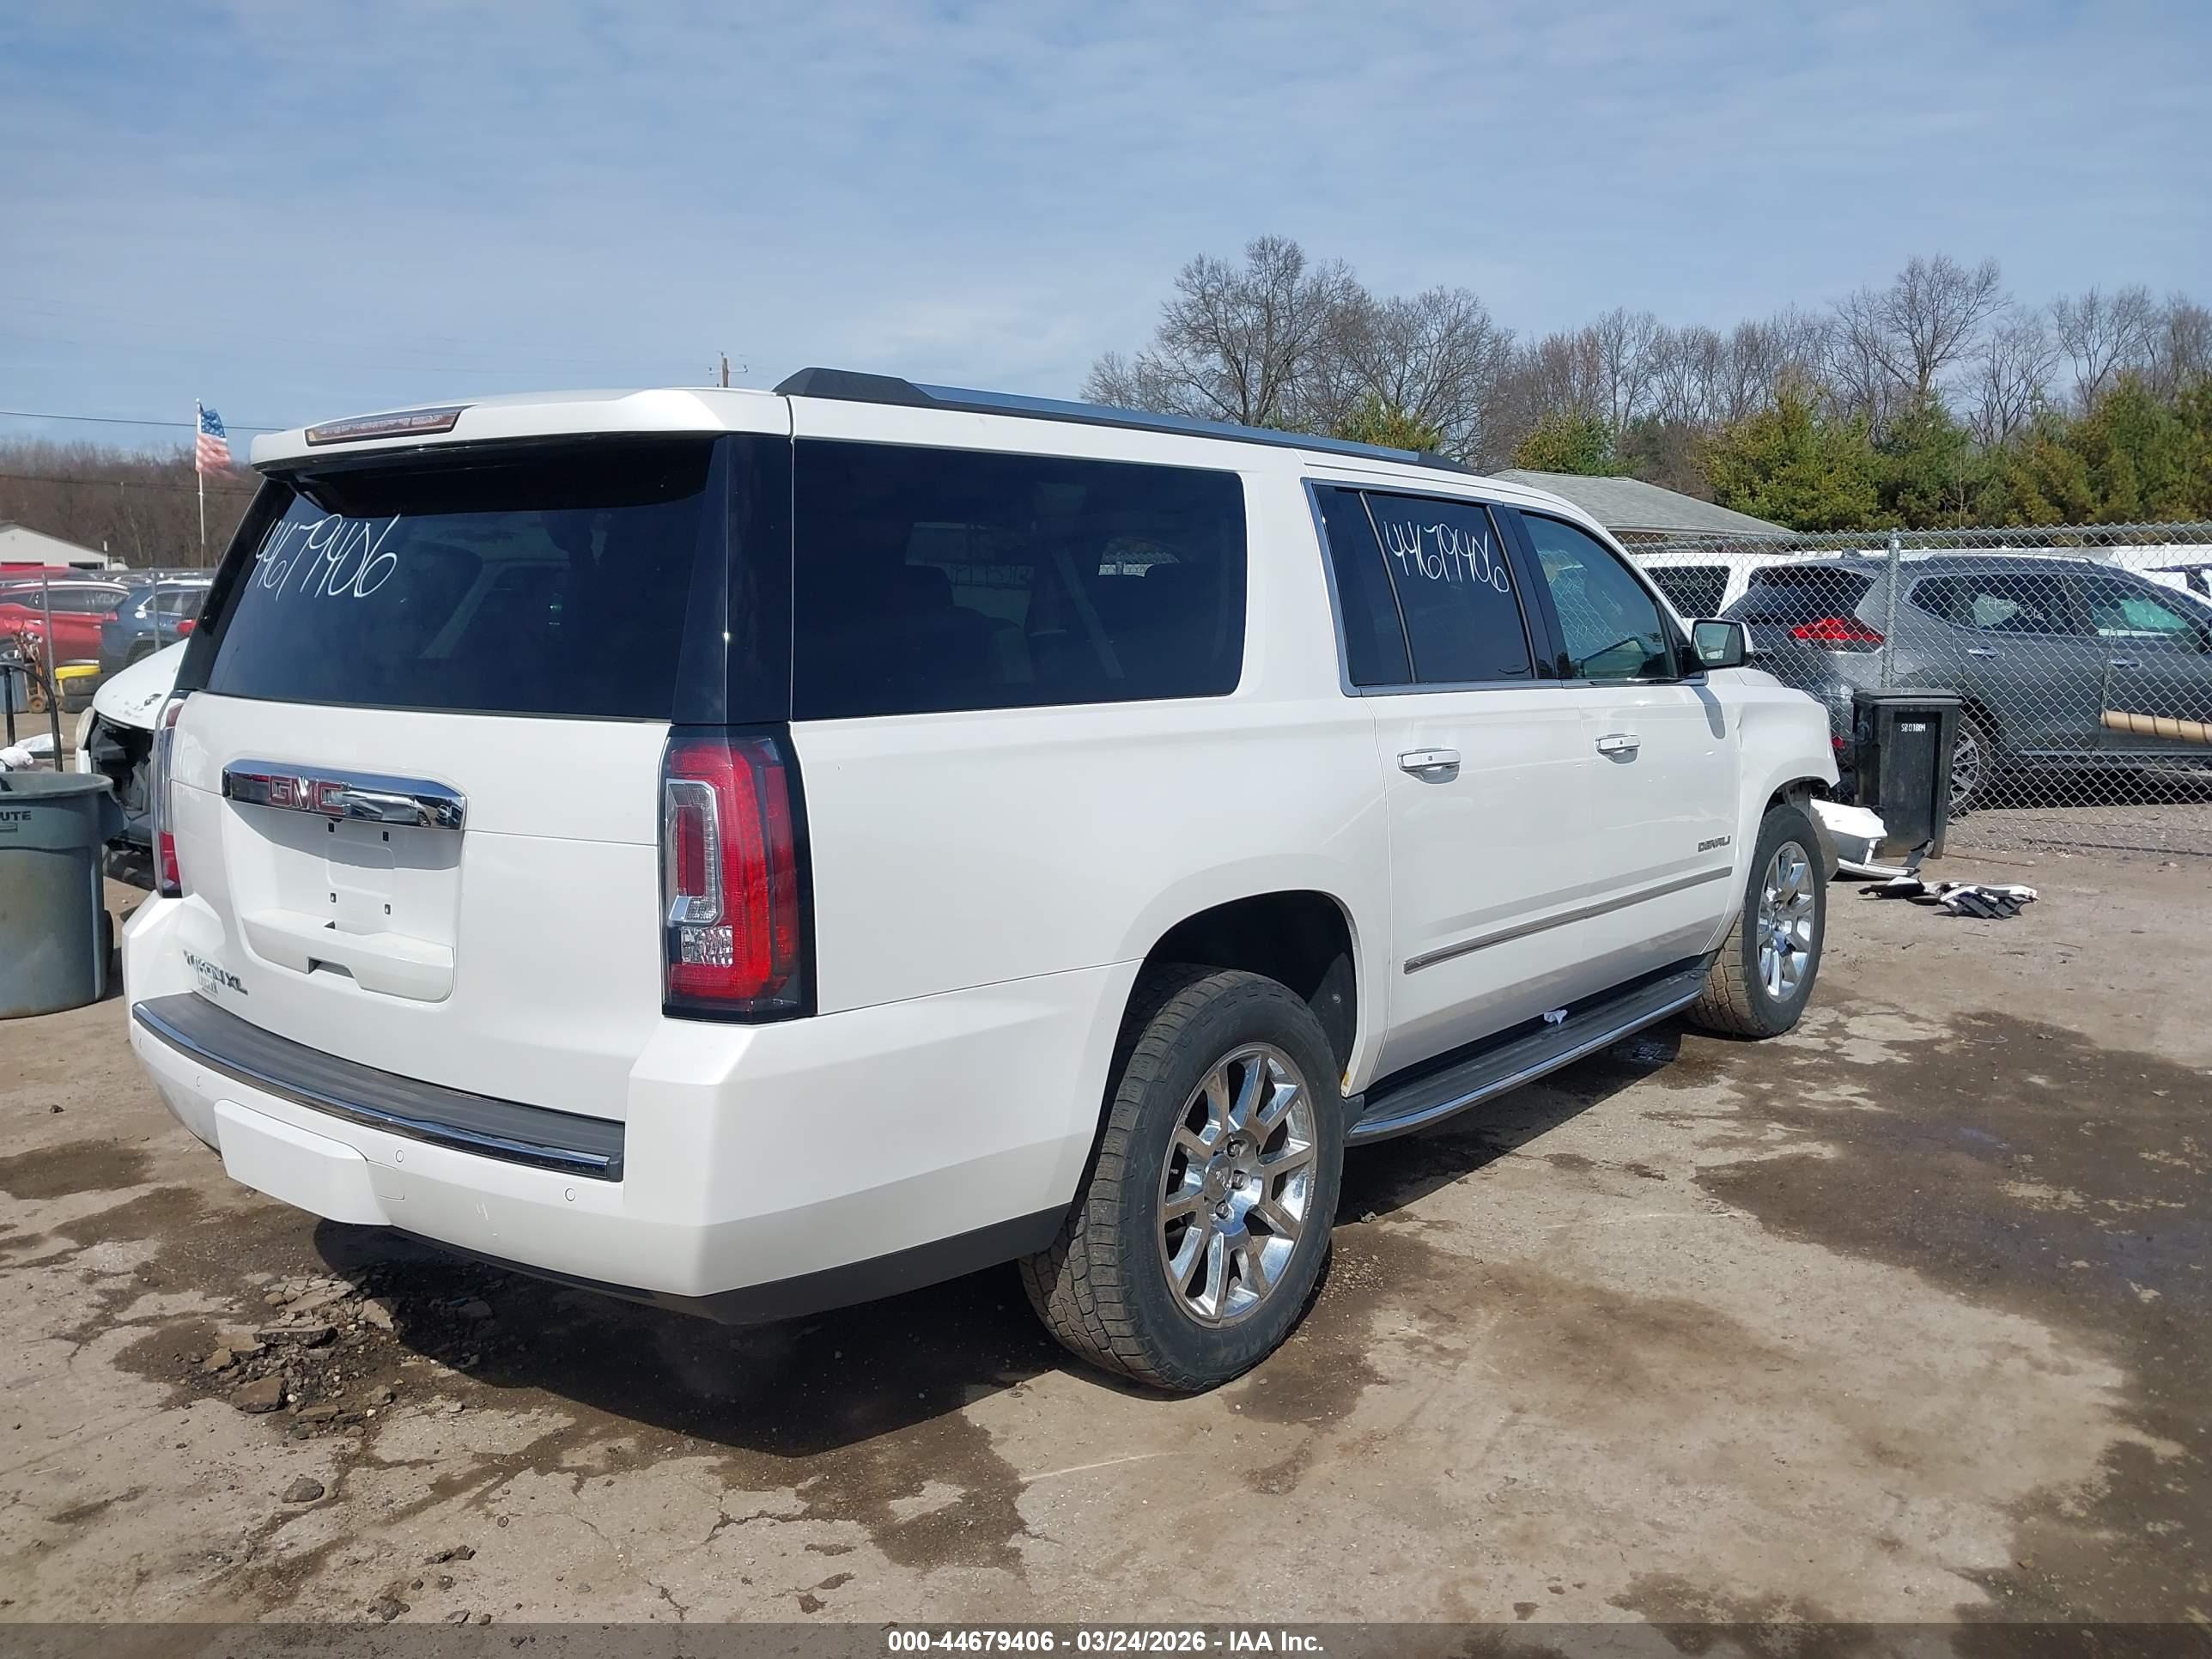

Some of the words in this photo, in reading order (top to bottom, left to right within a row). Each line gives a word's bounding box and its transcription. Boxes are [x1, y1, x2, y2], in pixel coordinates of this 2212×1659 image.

[244, 514, 401, 602] 44679406
[1383, 521, 1510, 593] 44679406
[269, 775, 350, 815] GMC
[1698, 835, 1731, 853] DENALI
[225, 970, 249, 996] XL
